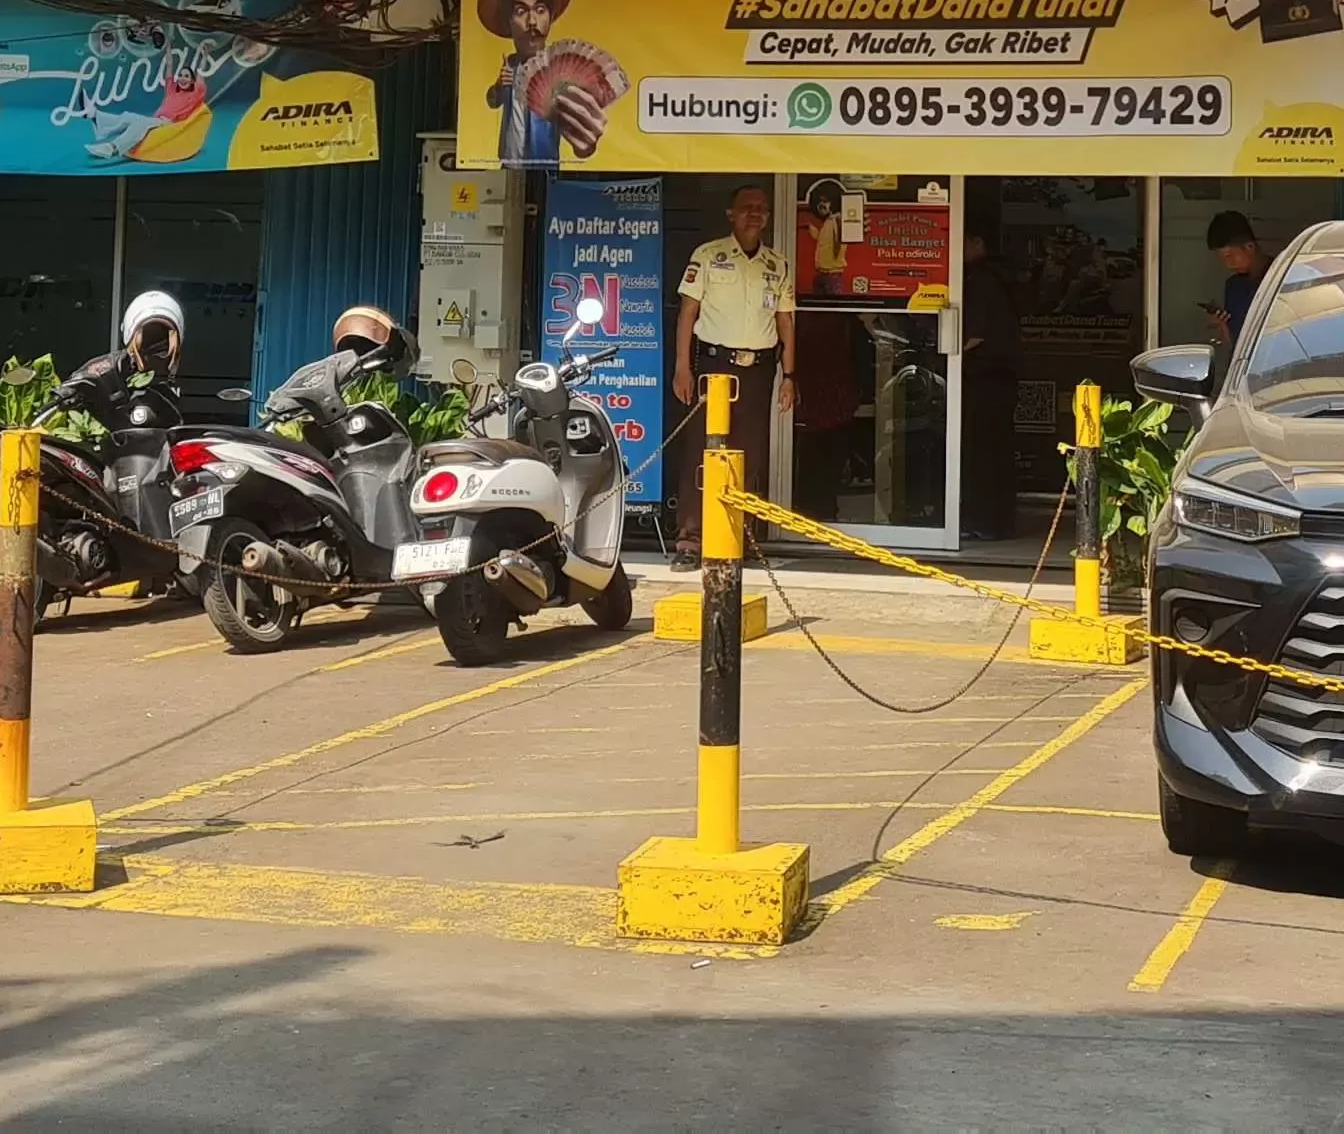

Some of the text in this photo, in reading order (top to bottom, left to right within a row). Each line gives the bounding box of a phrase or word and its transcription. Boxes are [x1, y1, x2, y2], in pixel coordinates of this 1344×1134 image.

[759, 31, 1072, 59] Cepat, Mudah, Gak Ribet
[260, 100, 353, 121] ADIRA
[647, 85, 1223, 127] Hubungi: 0895-3939-79429
[281, 116, 354, 128] FINANCE
[1258, 126, 1334, 139] ADIRA
[548, 216, 660, 240] Ayo Daftar Segera
[600, 244, 633, 268] Agen
[598, 373, 657, 389] Penghasilan
